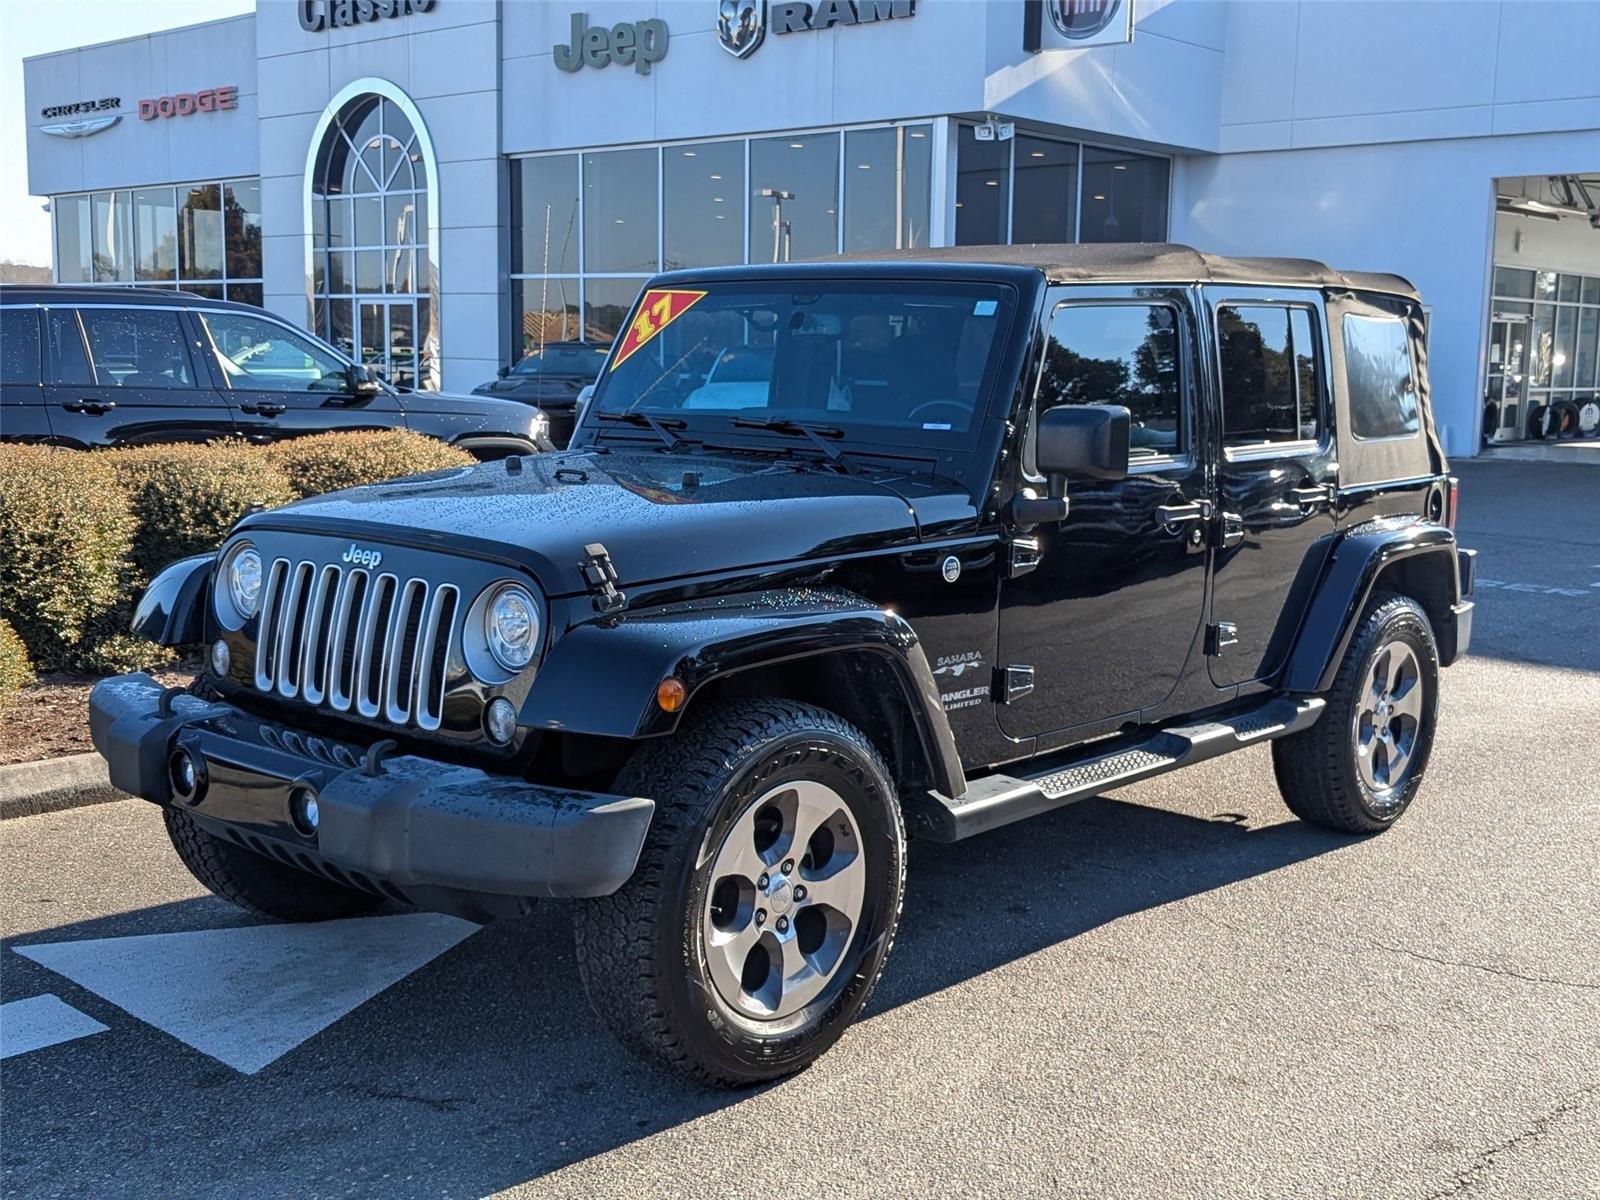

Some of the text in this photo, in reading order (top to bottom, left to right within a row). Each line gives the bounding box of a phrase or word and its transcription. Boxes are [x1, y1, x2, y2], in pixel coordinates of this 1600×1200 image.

[771, 0, 915, 35] RAM
[553, 12, 670, 76] Jeep
[41, 97, 121, 119] CHRYSLER
[138, 86, 238, 121] DODGE
[633, 292, 672, 343] 17
[342, 543, 383, 570] Jeep
[936, 650, 982, 667] SAHARA
[941, 686, 990, 702] ANGLER
[944, 698, 982, 711] LIMITED
